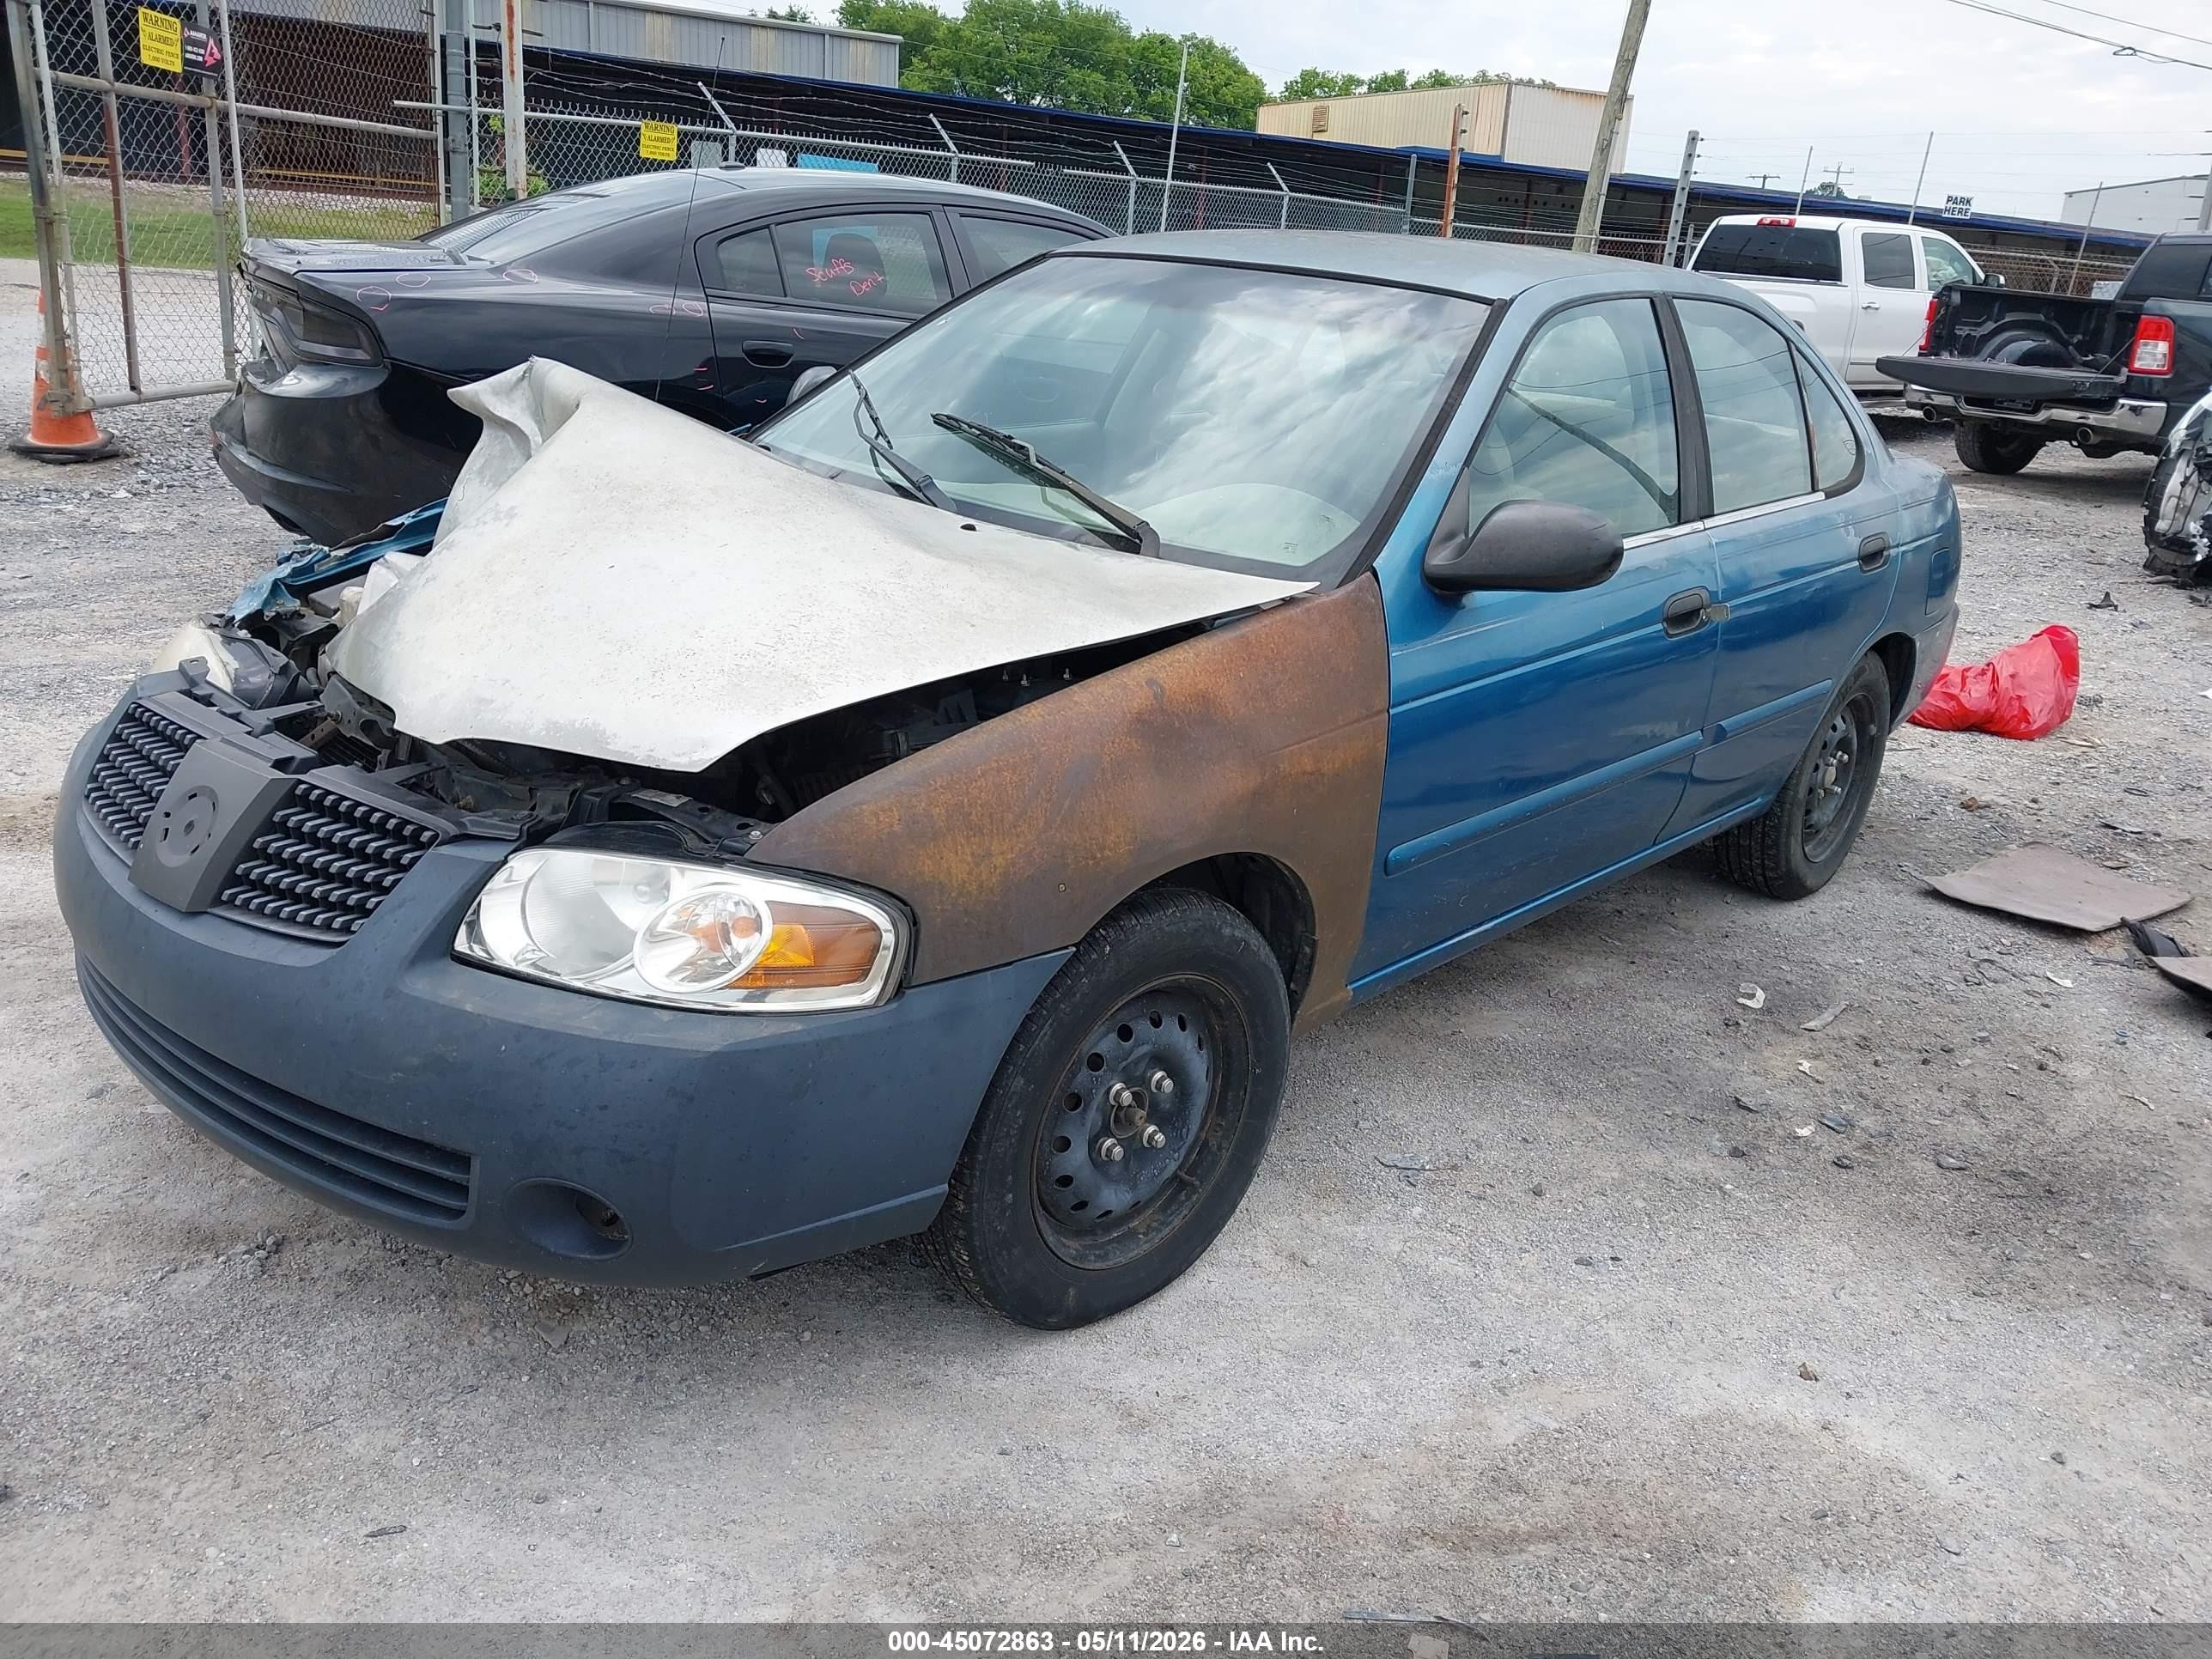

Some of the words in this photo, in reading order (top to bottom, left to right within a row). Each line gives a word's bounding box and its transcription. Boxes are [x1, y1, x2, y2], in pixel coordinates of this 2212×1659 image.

[142, 11, 178, 32] WARNING
[147, 32, 173, 46] ALARMED
[143, 44, 164, 56] ELECTRIC
[165, 51, 179, 59] FENCE
[161, 58, 175, 66] VOLTS
[644, 122, 674, 133] WARNING
[647, 135, 671, 144] ALARMED
[1946, 196, 1972, 207] PARK
[1943, 206, 1971, 217] HERE
[805, 258, 854, 283] Scuffs
[849, 270, 884, 296] Dent
